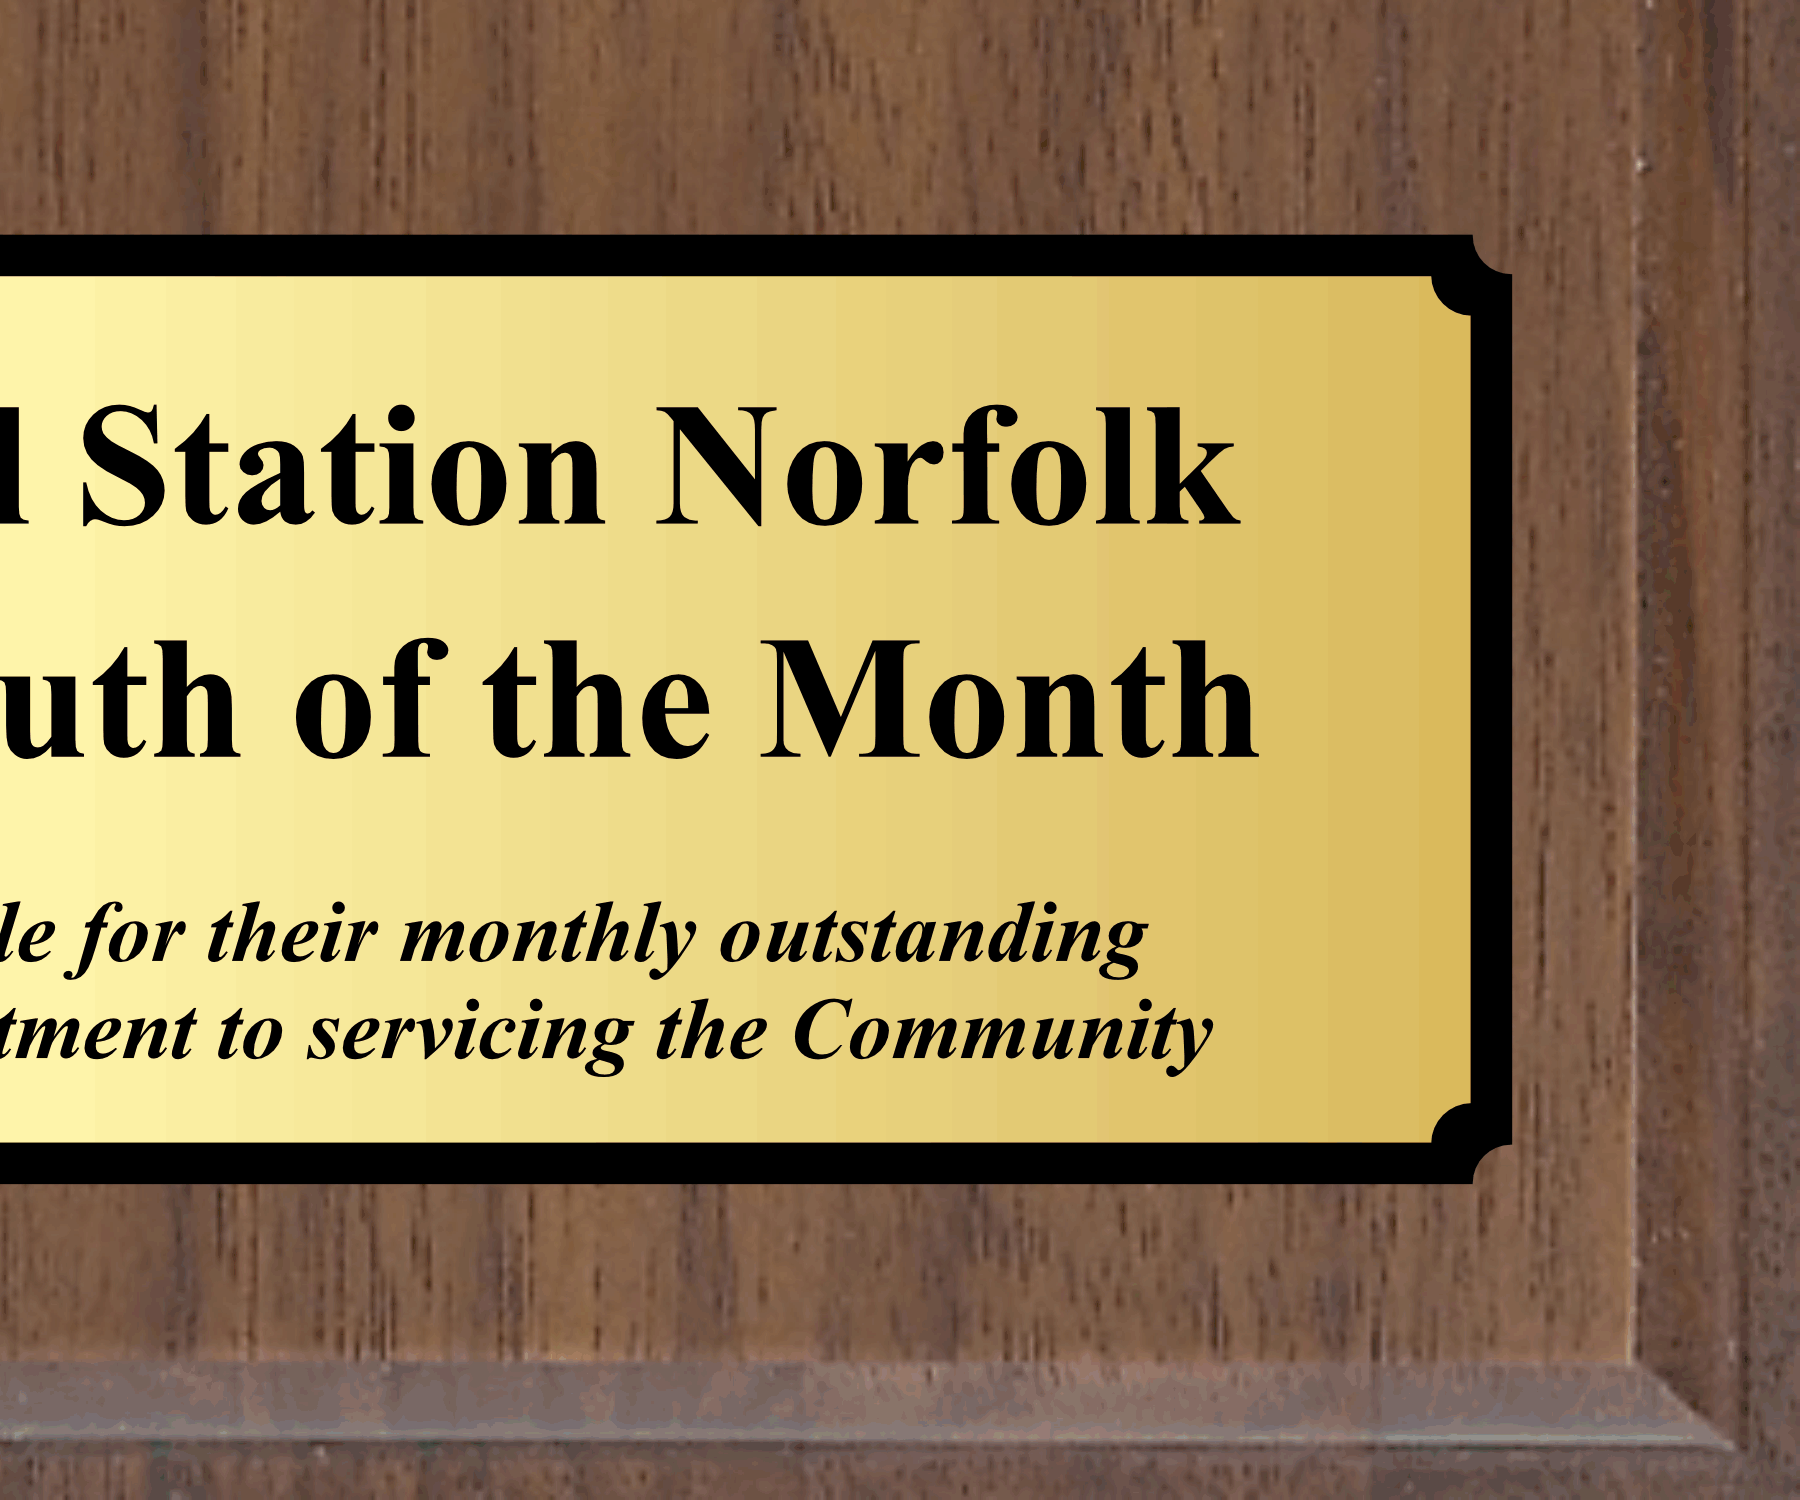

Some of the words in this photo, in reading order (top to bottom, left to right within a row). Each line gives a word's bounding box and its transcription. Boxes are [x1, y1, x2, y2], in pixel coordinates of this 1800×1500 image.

[83, 405, 605, 526] Station
[656, 405, 1241, 526] Norfolk
[296, 638, 448, 759] of
[483, 640, 709, 759] the
[761, 640, 1259, 759] Month
[63, 902, 186, 980] for
[208, 902, 378, 962] their
[400, 902, 696, 980] monthly
[721, 901, 1149, 980] outstanding
[218, 1008, 282, 1059] to
[307, 999, 635, 1077] servicing
[657, 999, 767, 1059] the
[795, 999, 1213, 1077] Community
